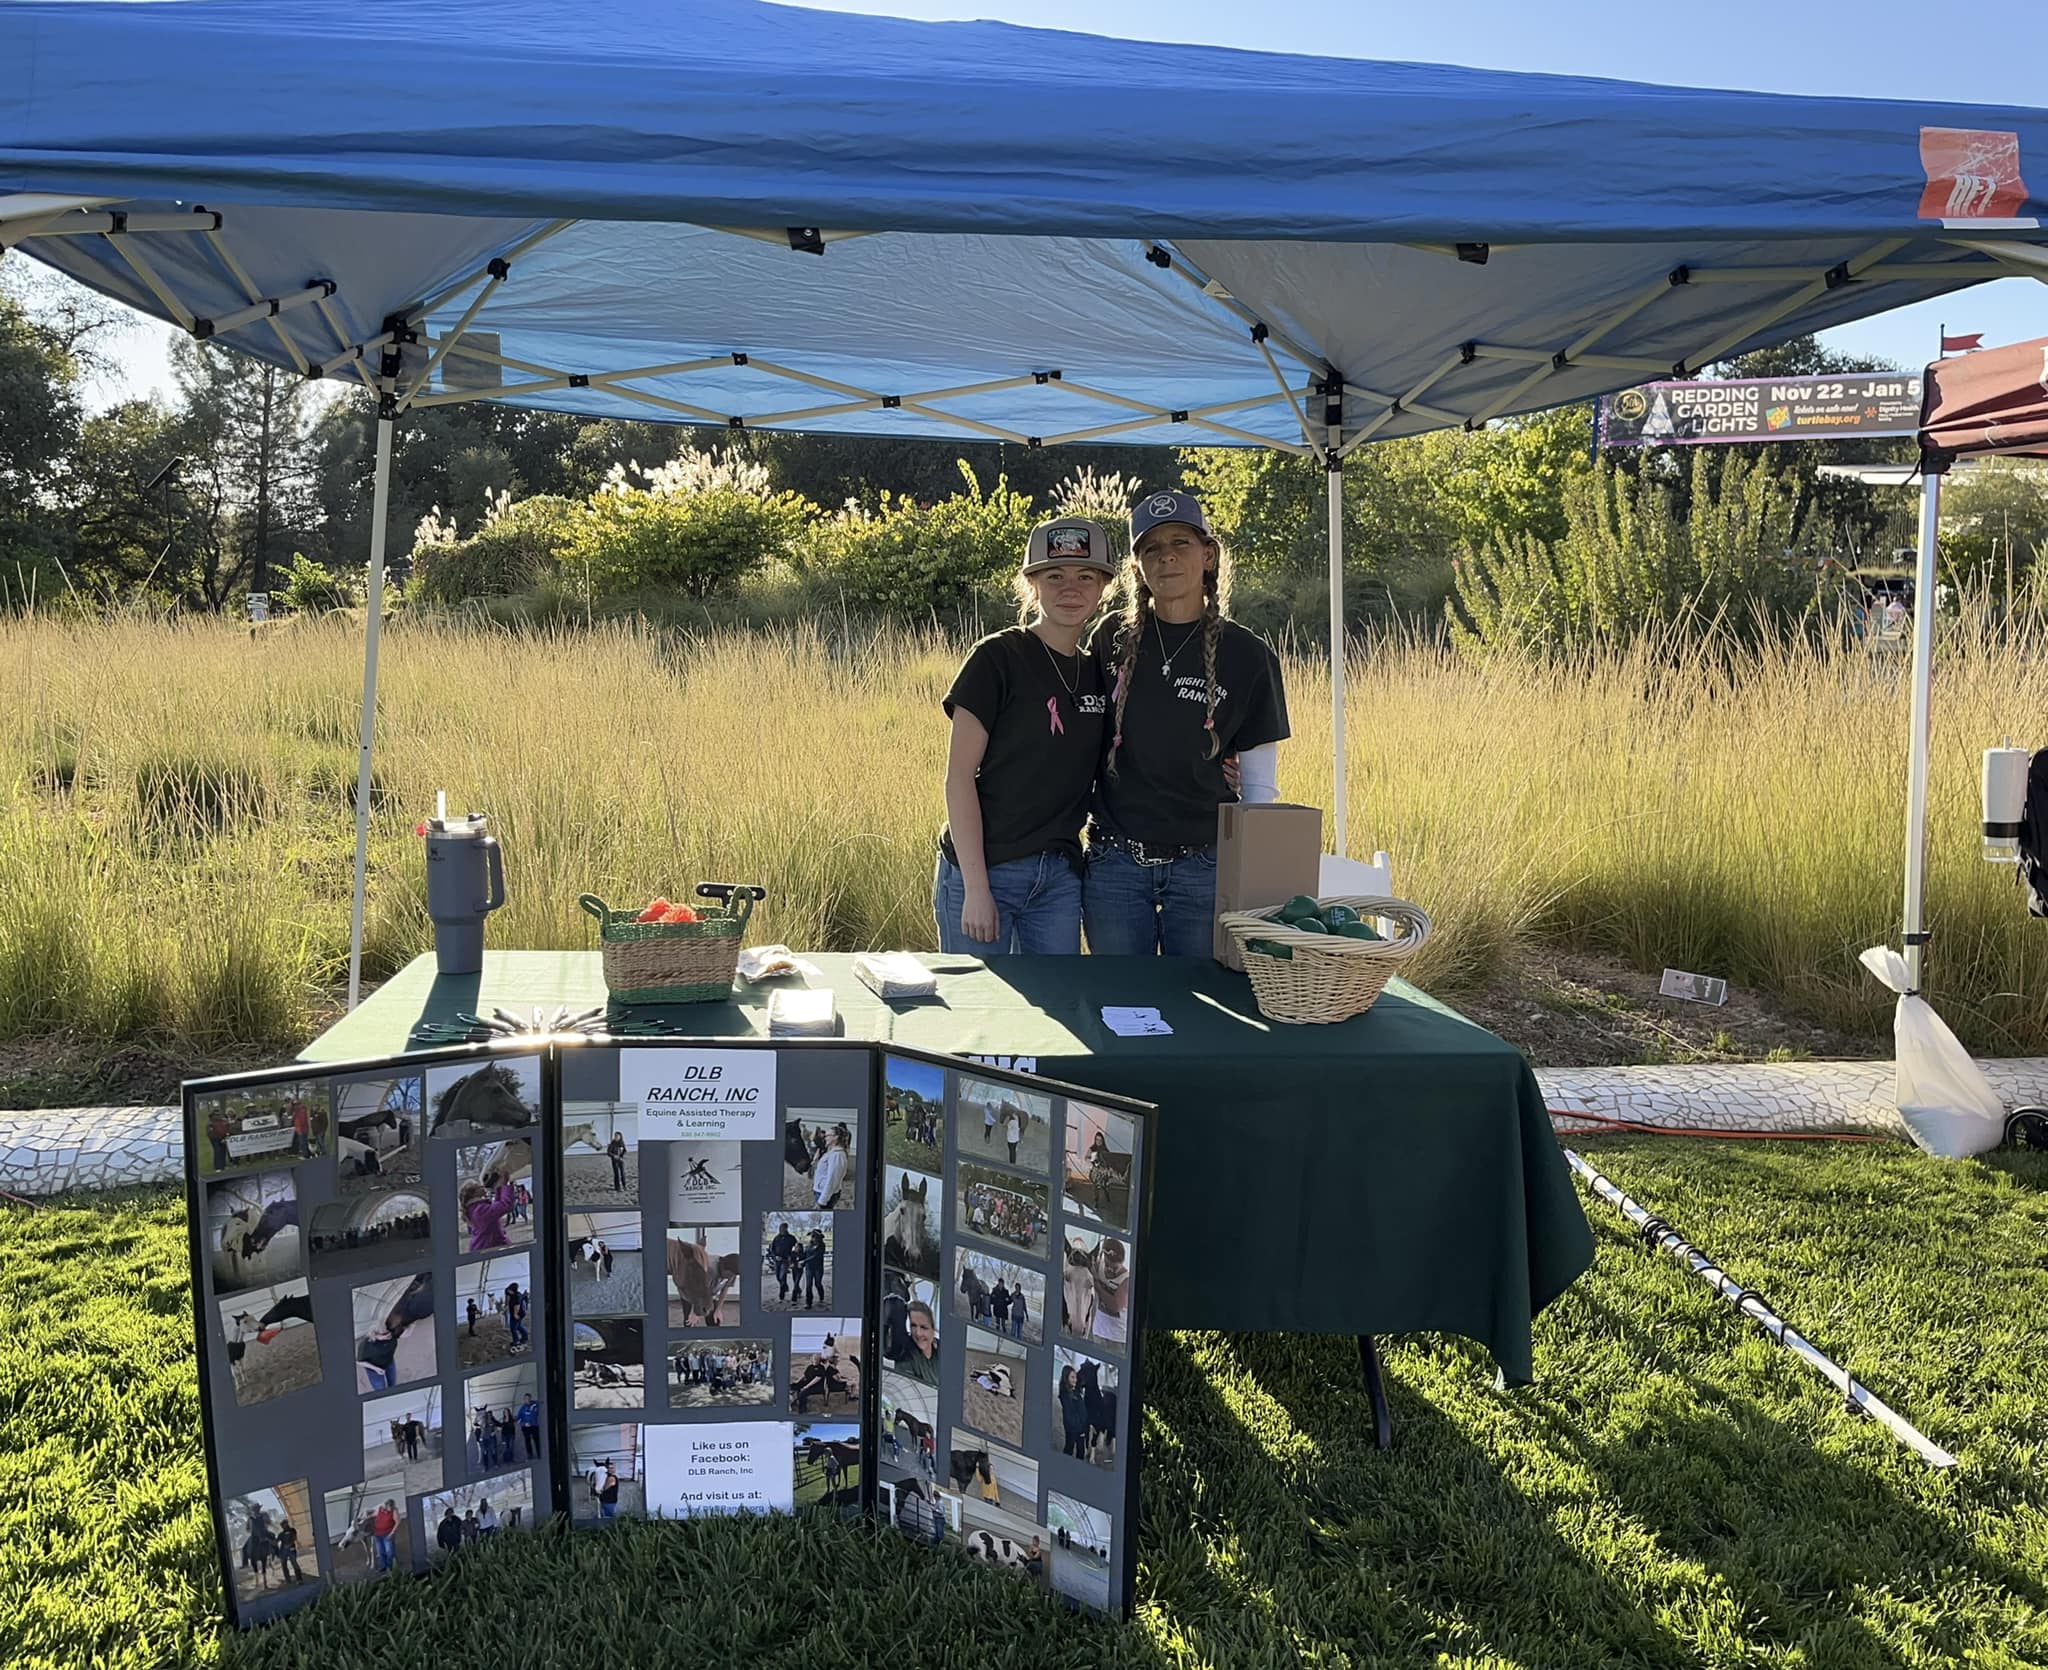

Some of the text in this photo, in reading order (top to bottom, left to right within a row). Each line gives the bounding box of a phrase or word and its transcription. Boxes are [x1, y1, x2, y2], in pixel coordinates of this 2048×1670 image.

[1671, 387, 1760, 404] REDDING
[1771, 386, 1812, 401] Nov
[1817, 383, 1843, 399] 22
[1862, 382, 1902, 398] Jan
[1907, 379, 1921, 396] 5
[1677, 402, 1758, 418] GARDEN
[1692, 416, 1758, 433] LIGHTS
[1797, 414, 1861, 425] turtlebay.org
[684, 1066, 722, 1080] DLB
[647, 1087, 759, 1103] RANCH, INC
[646, 1108, 756, 1119] Equine Assisted Therapy
[686, 1120, 725, 1129] Learning
[692, 1441, 749, 1450] Like us on
[691, 1453, 751, 1463] Facebook:
[688, 1468, 706, 1476] DLB
[708, 1468, 738, 1476] Ranch,
[680, 1490, 762, 1500] And visit us at:
